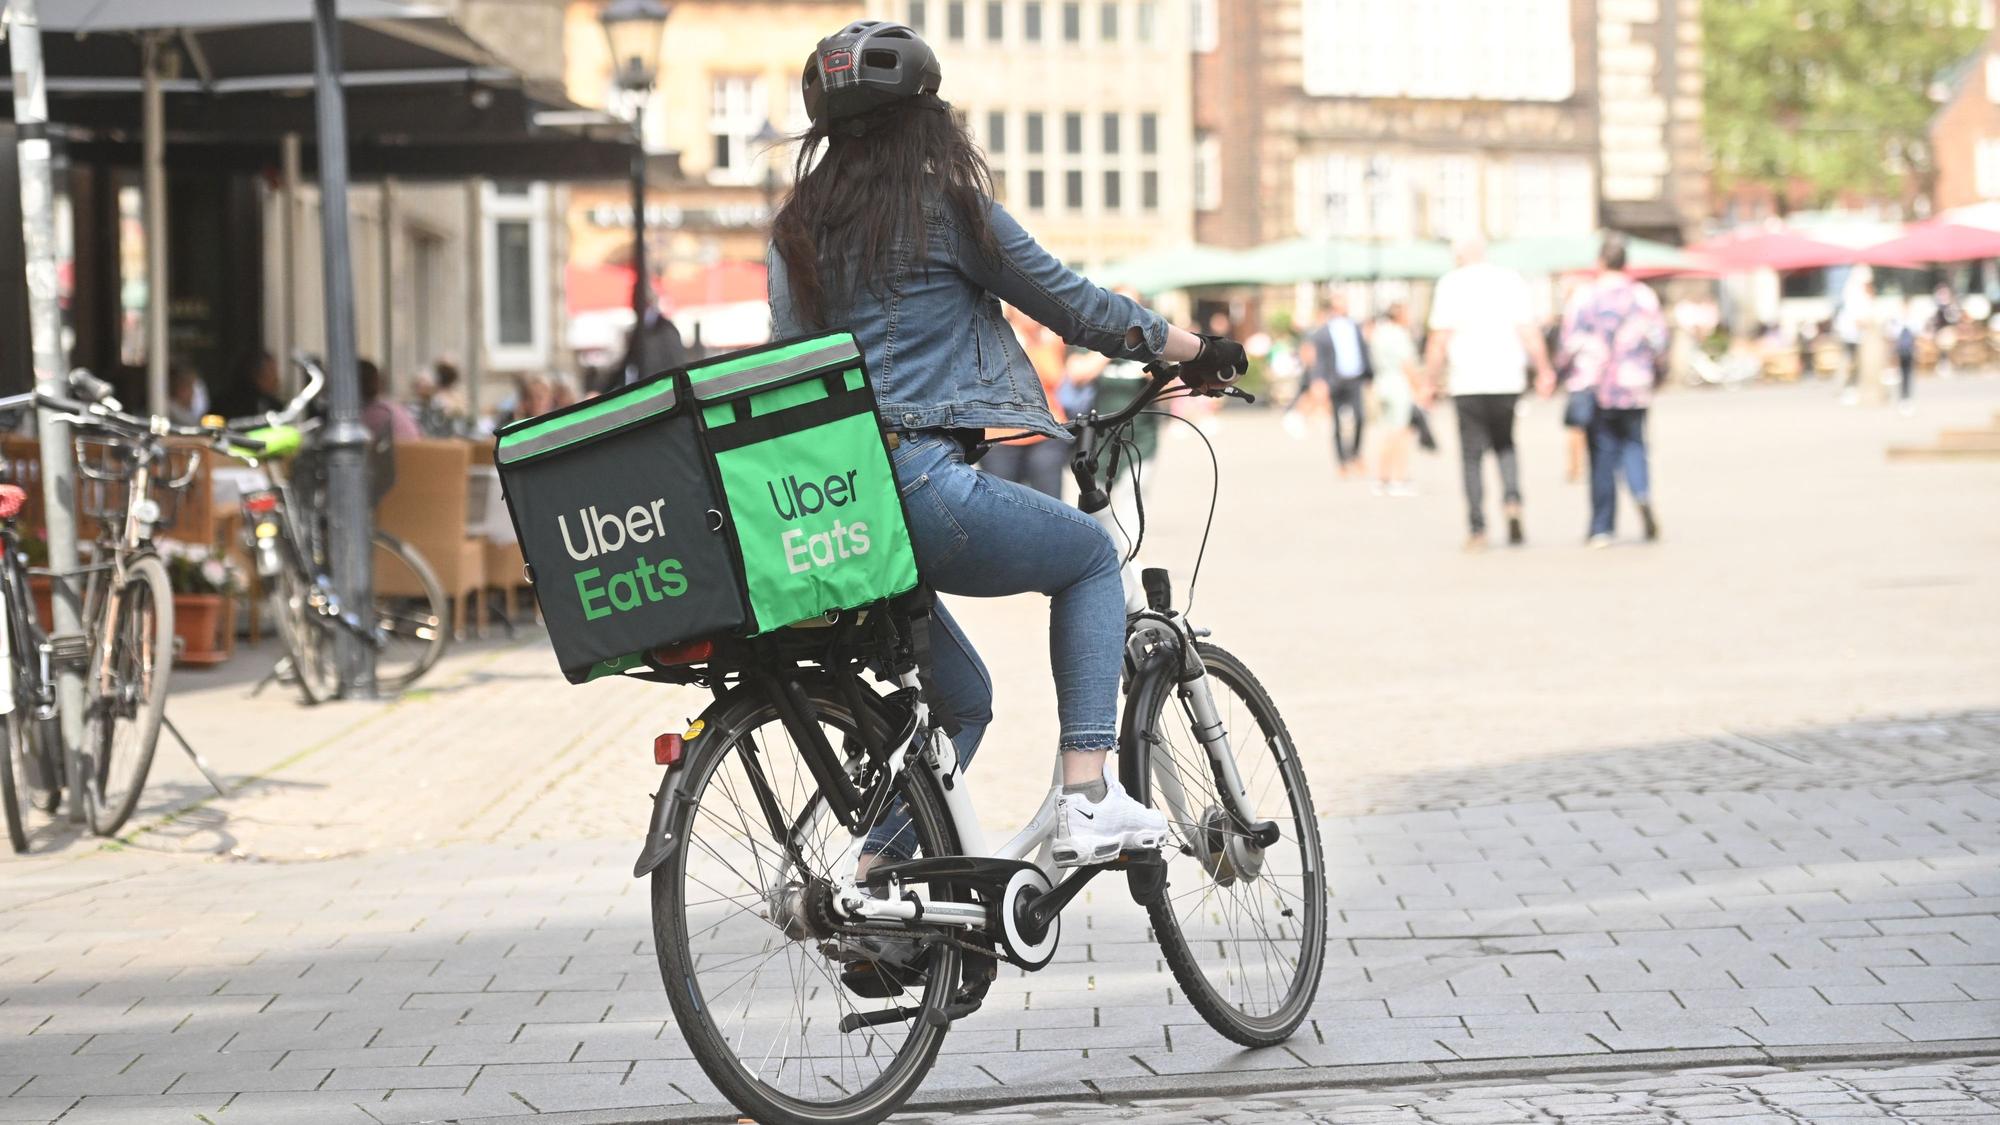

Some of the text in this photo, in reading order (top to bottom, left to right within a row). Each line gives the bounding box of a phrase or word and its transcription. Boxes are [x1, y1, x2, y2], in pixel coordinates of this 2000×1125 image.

[767, 469, 857, 521] Uber
[558, 498, 665, 561] Uber
[781, 519, 870, 574] Eats
[574, 557, 688, 620] Eats
